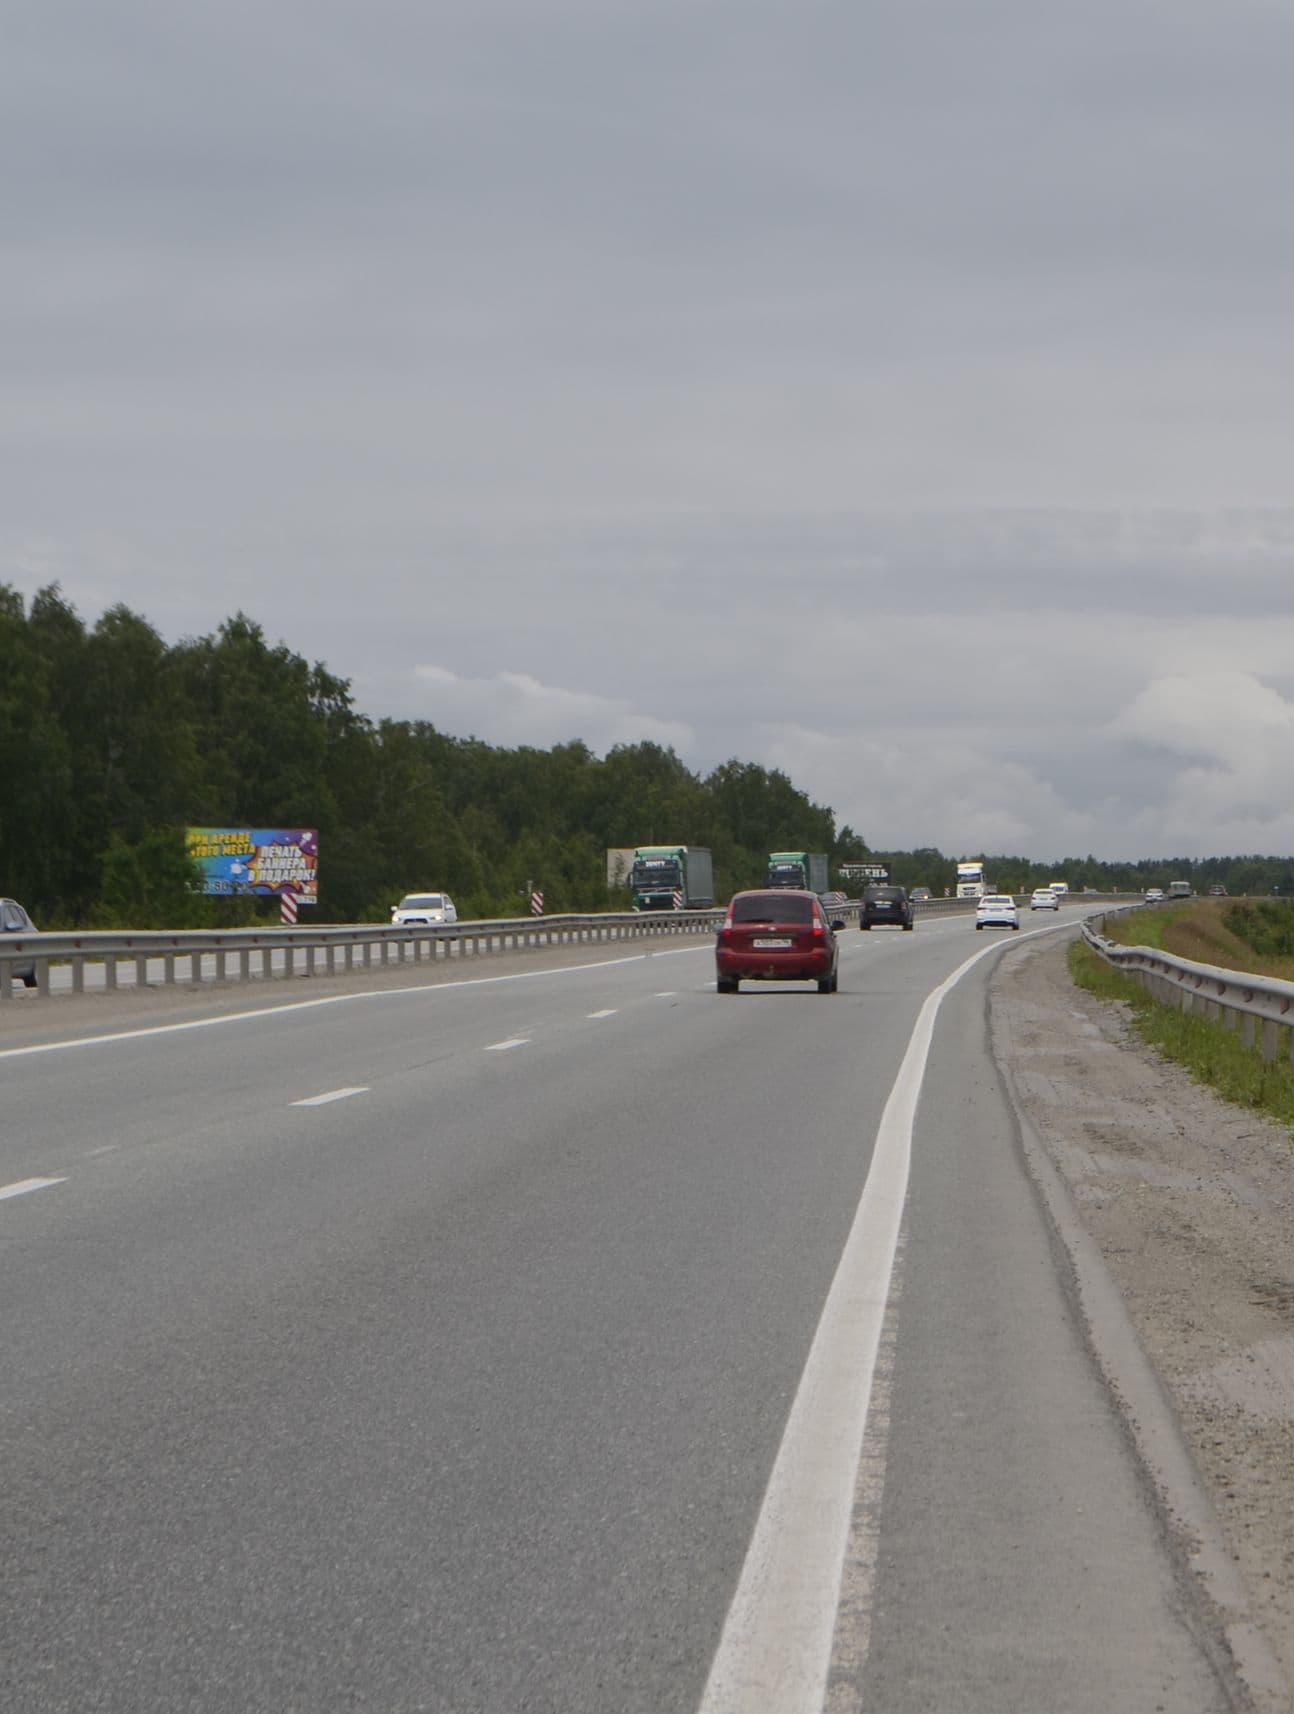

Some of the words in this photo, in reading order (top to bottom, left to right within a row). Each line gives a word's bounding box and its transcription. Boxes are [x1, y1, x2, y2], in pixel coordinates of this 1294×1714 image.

[261, 846, 302, 858] ПЕЧАТЬ
[257, 857, 306, 869] БАННЕРА
[258, 869, 316, 882] ПОДАРОК!
